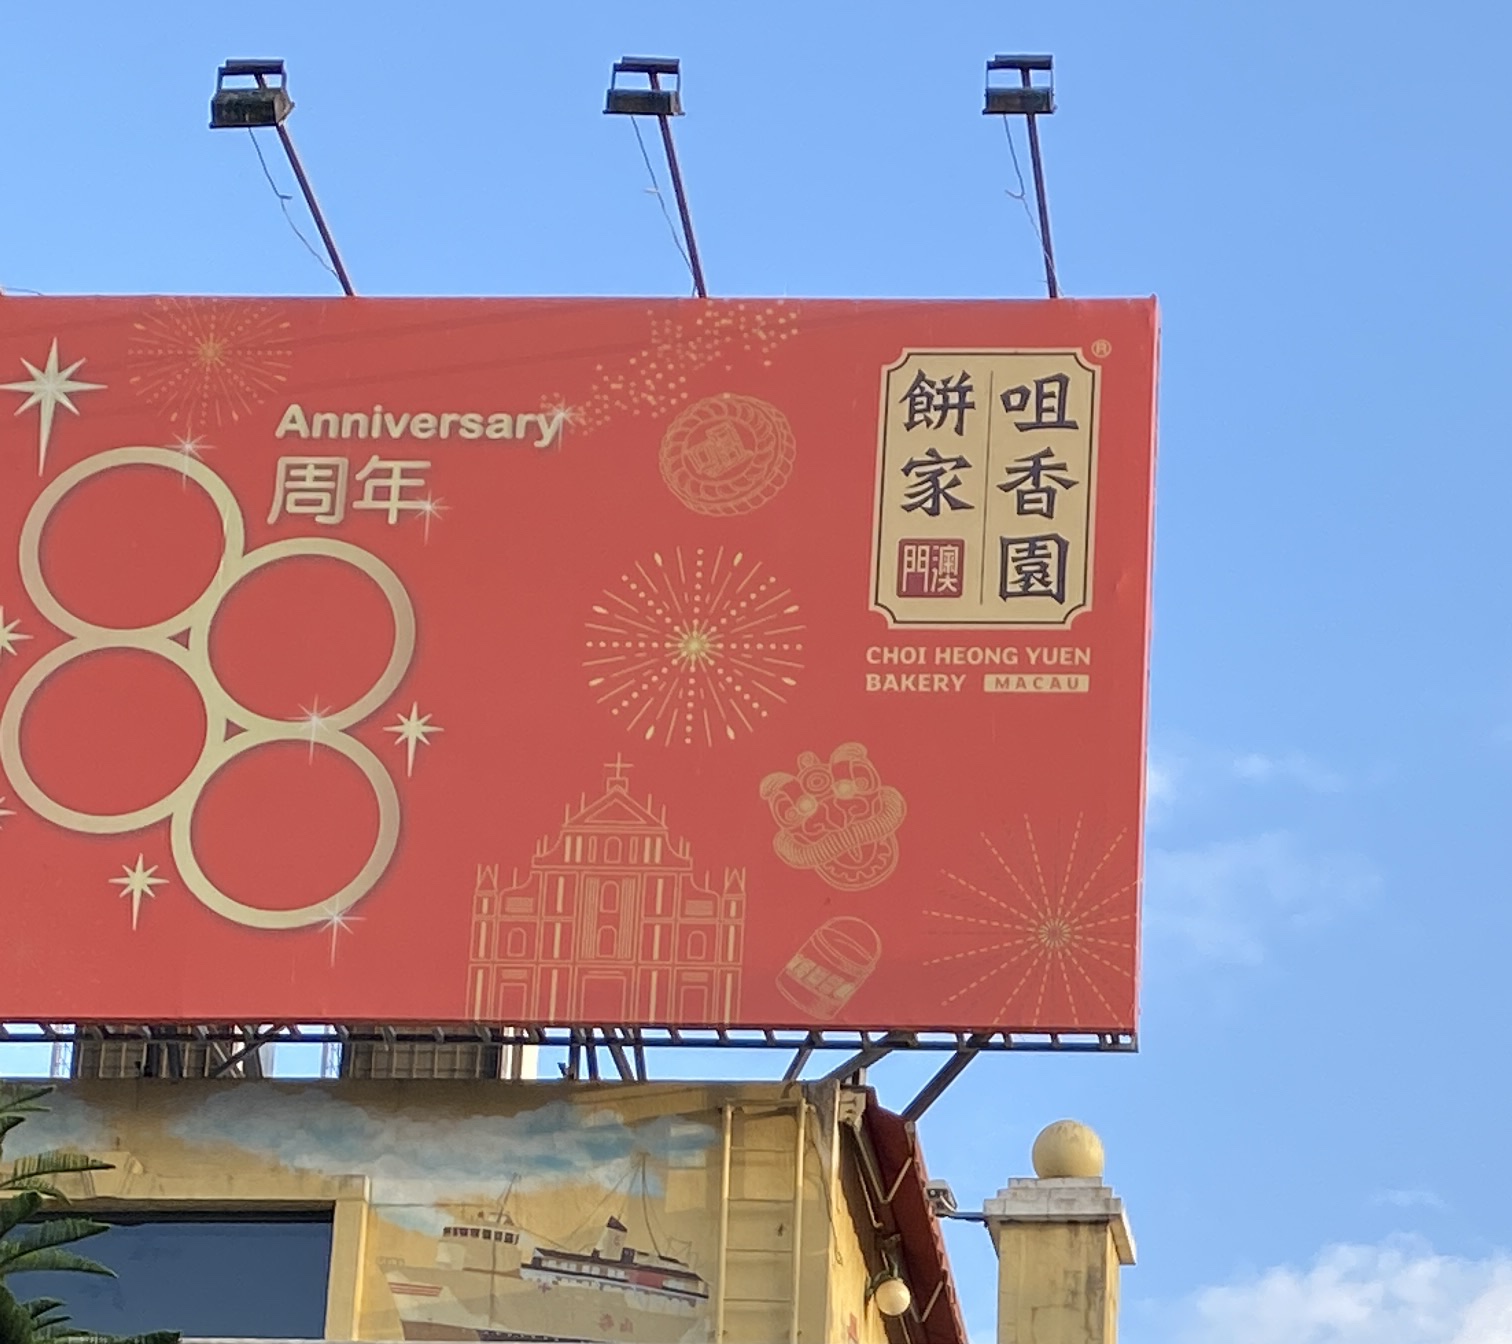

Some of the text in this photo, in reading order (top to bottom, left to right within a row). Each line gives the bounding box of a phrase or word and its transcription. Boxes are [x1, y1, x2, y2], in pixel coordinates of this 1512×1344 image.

[275, 403, 559, 447] Anniversary
[267, 455, 432, 525] 周年
[866, 647, 1091, 666] CHOI HEONG YUEN
[865, 674, 1080, 692] BAKERY MACAU
